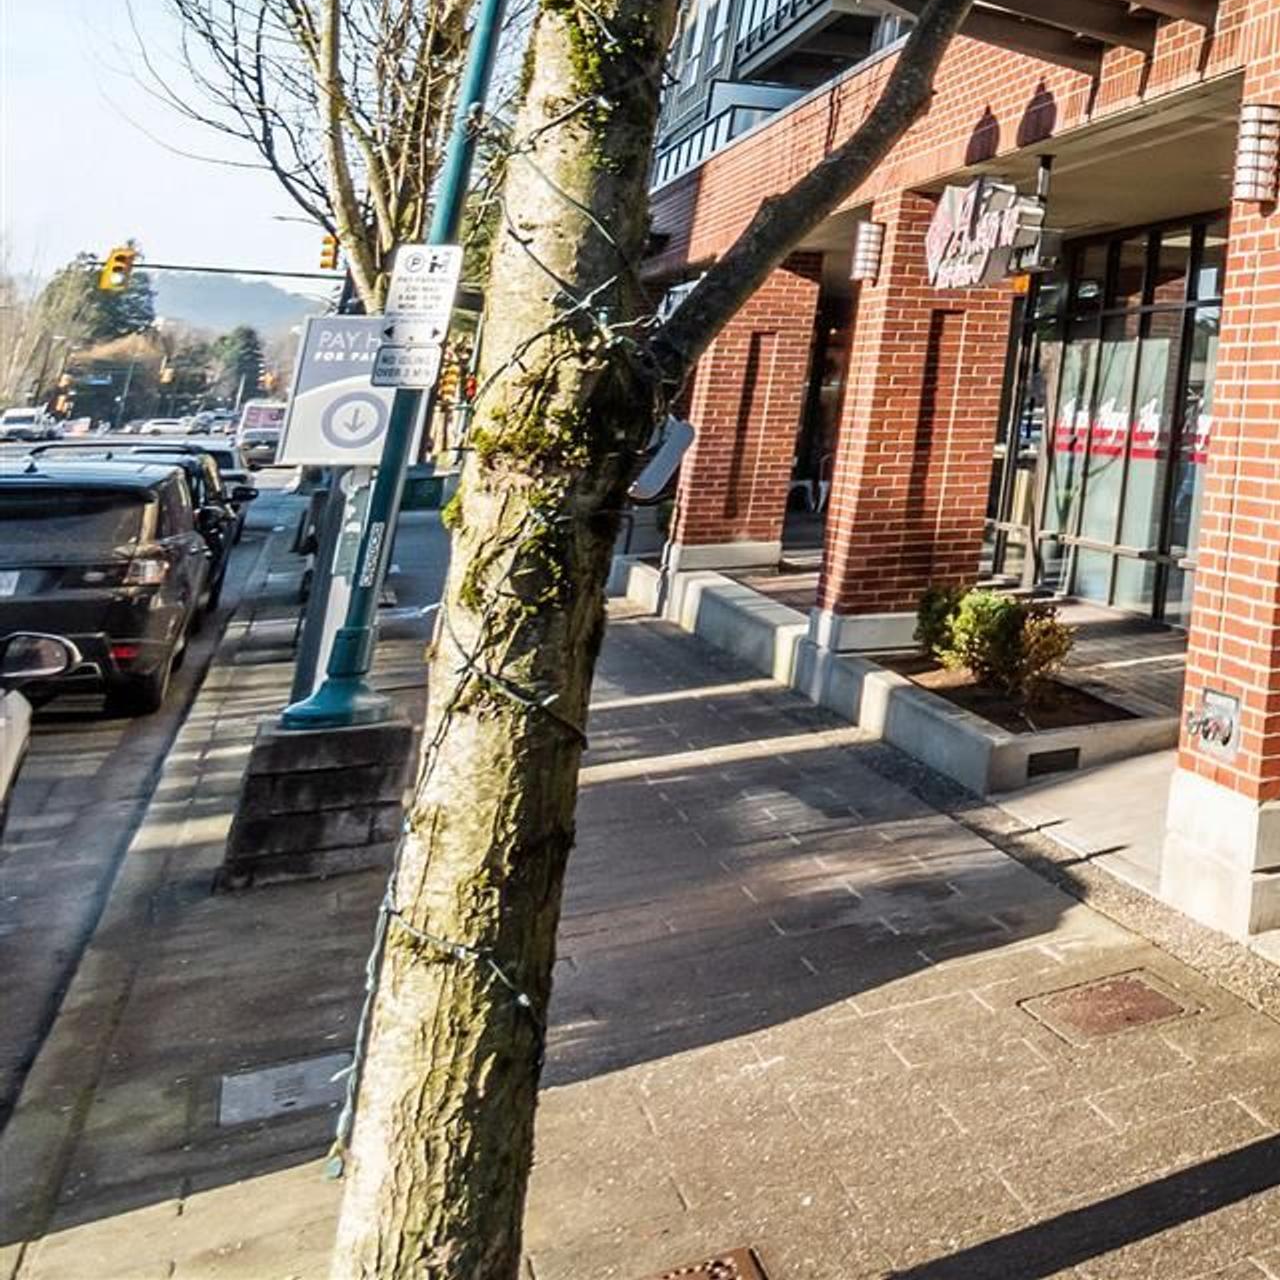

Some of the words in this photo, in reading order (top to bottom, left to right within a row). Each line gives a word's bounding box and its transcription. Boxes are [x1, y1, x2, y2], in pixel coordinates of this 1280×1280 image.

[319, 330, 362, 350] PAY
[313, 351, 345, 362] FOR
[375, 367, 401, 378] OVER
